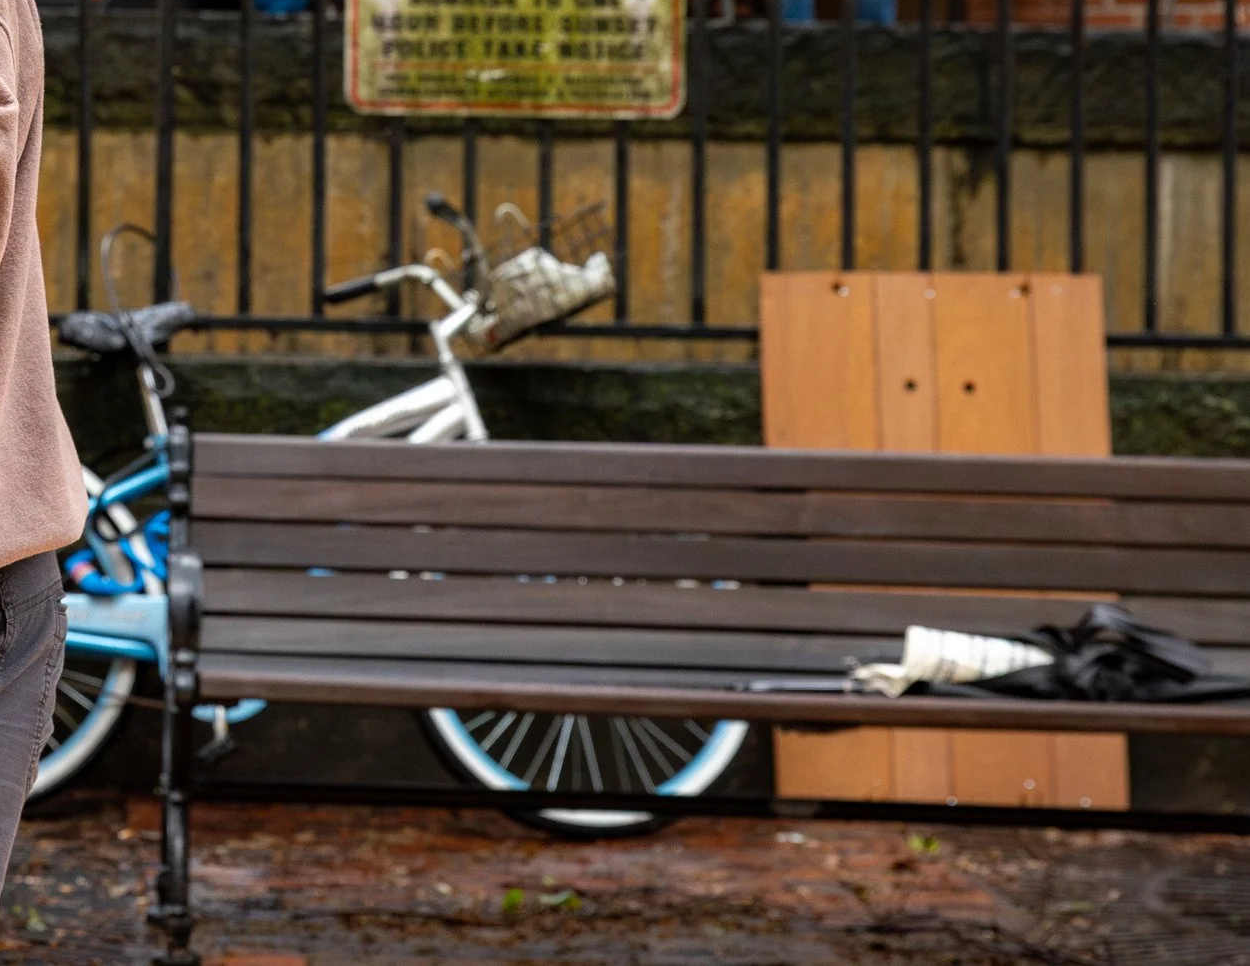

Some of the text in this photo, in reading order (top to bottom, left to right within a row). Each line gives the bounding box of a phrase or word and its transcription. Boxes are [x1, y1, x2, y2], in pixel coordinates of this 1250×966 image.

[372, 11, 658, 34] HOUR BEFORE SUNSET
[382, 37, 644, 60] POLICE TAKE NOTICE
